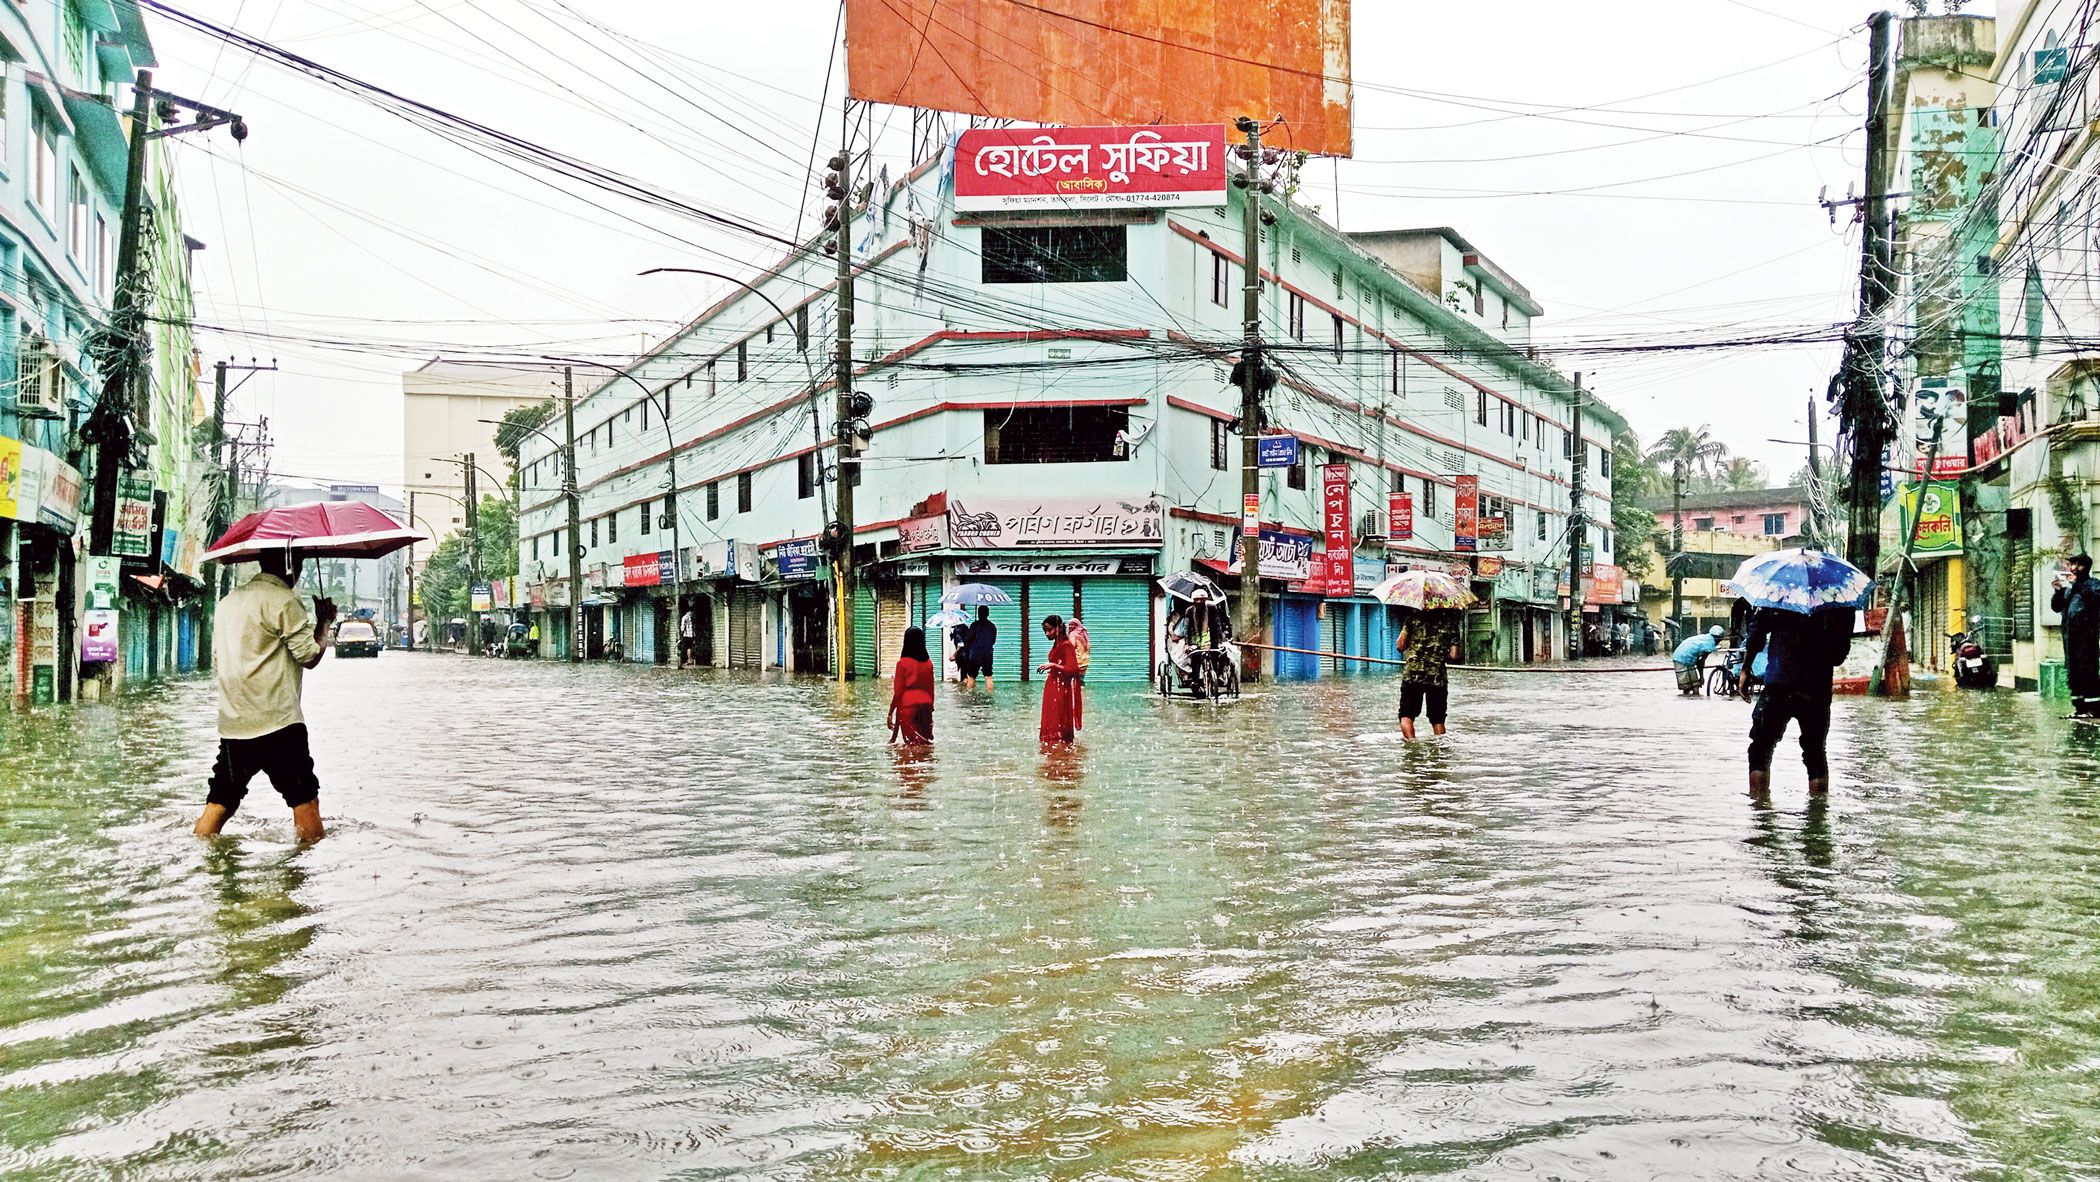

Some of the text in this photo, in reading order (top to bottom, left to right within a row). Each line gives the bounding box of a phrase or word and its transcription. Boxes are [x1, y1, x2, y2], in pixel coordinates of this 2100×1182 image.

[975, 131, 1210, 184] হোটেল সুফিয়া
[1056, 179, 1108, 193] (আবাসিক)
[1126, 193, 1180, 202] 01774-420874
[1003, 503, 1120, 536] পার্বণ কর্ণার
